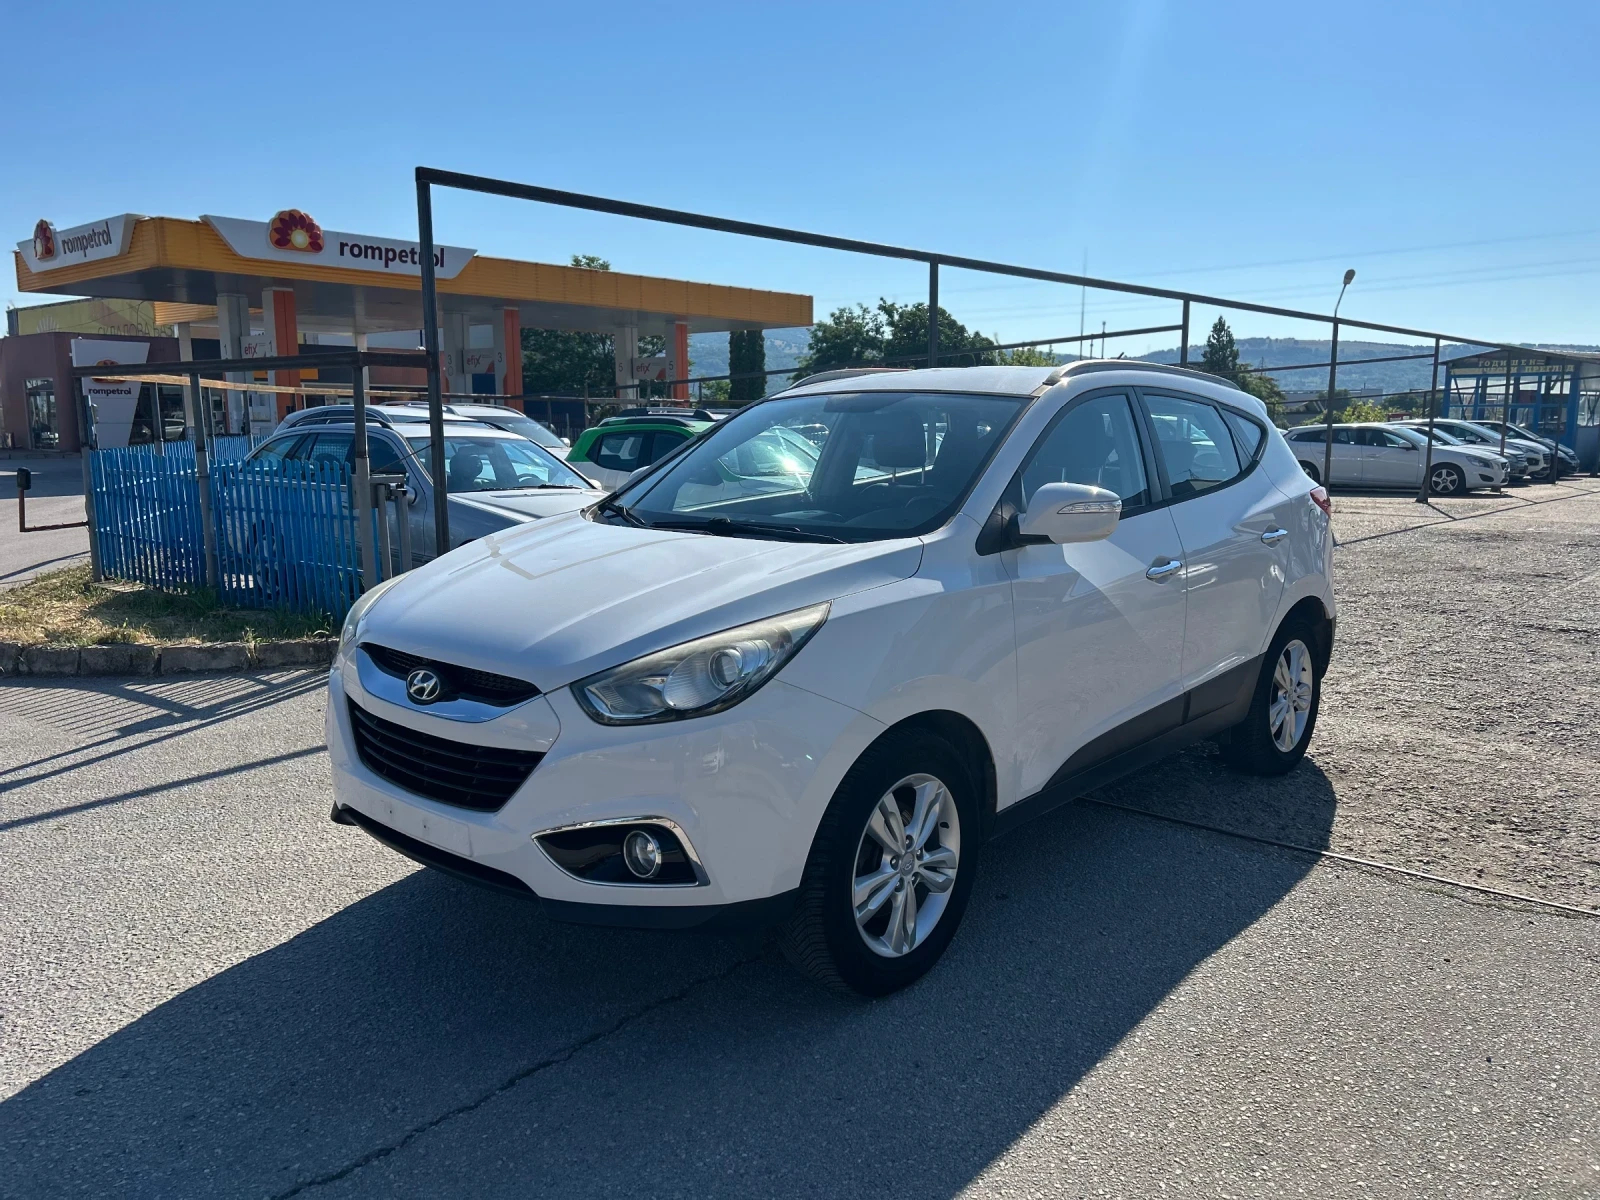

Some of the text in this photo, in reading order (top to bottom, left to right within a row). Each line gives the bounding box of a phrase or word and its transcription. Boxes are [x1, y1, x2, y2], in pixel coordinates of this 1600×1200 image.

[61, 221, 112, 257] rompetrol
[339, 241, 445, 268] rompetl
[244, 342, 258, 358] efix
[447, 354, 453, 365] 3
[466, 354, 482, 368] efix
[497, 351, 503, 363] 3
[618, 362, 624, 373] 5
[636, 362, 651, 375] efix
[668, 360, 674, 371] 5
[88, 387, 132, 397] rompetrol
